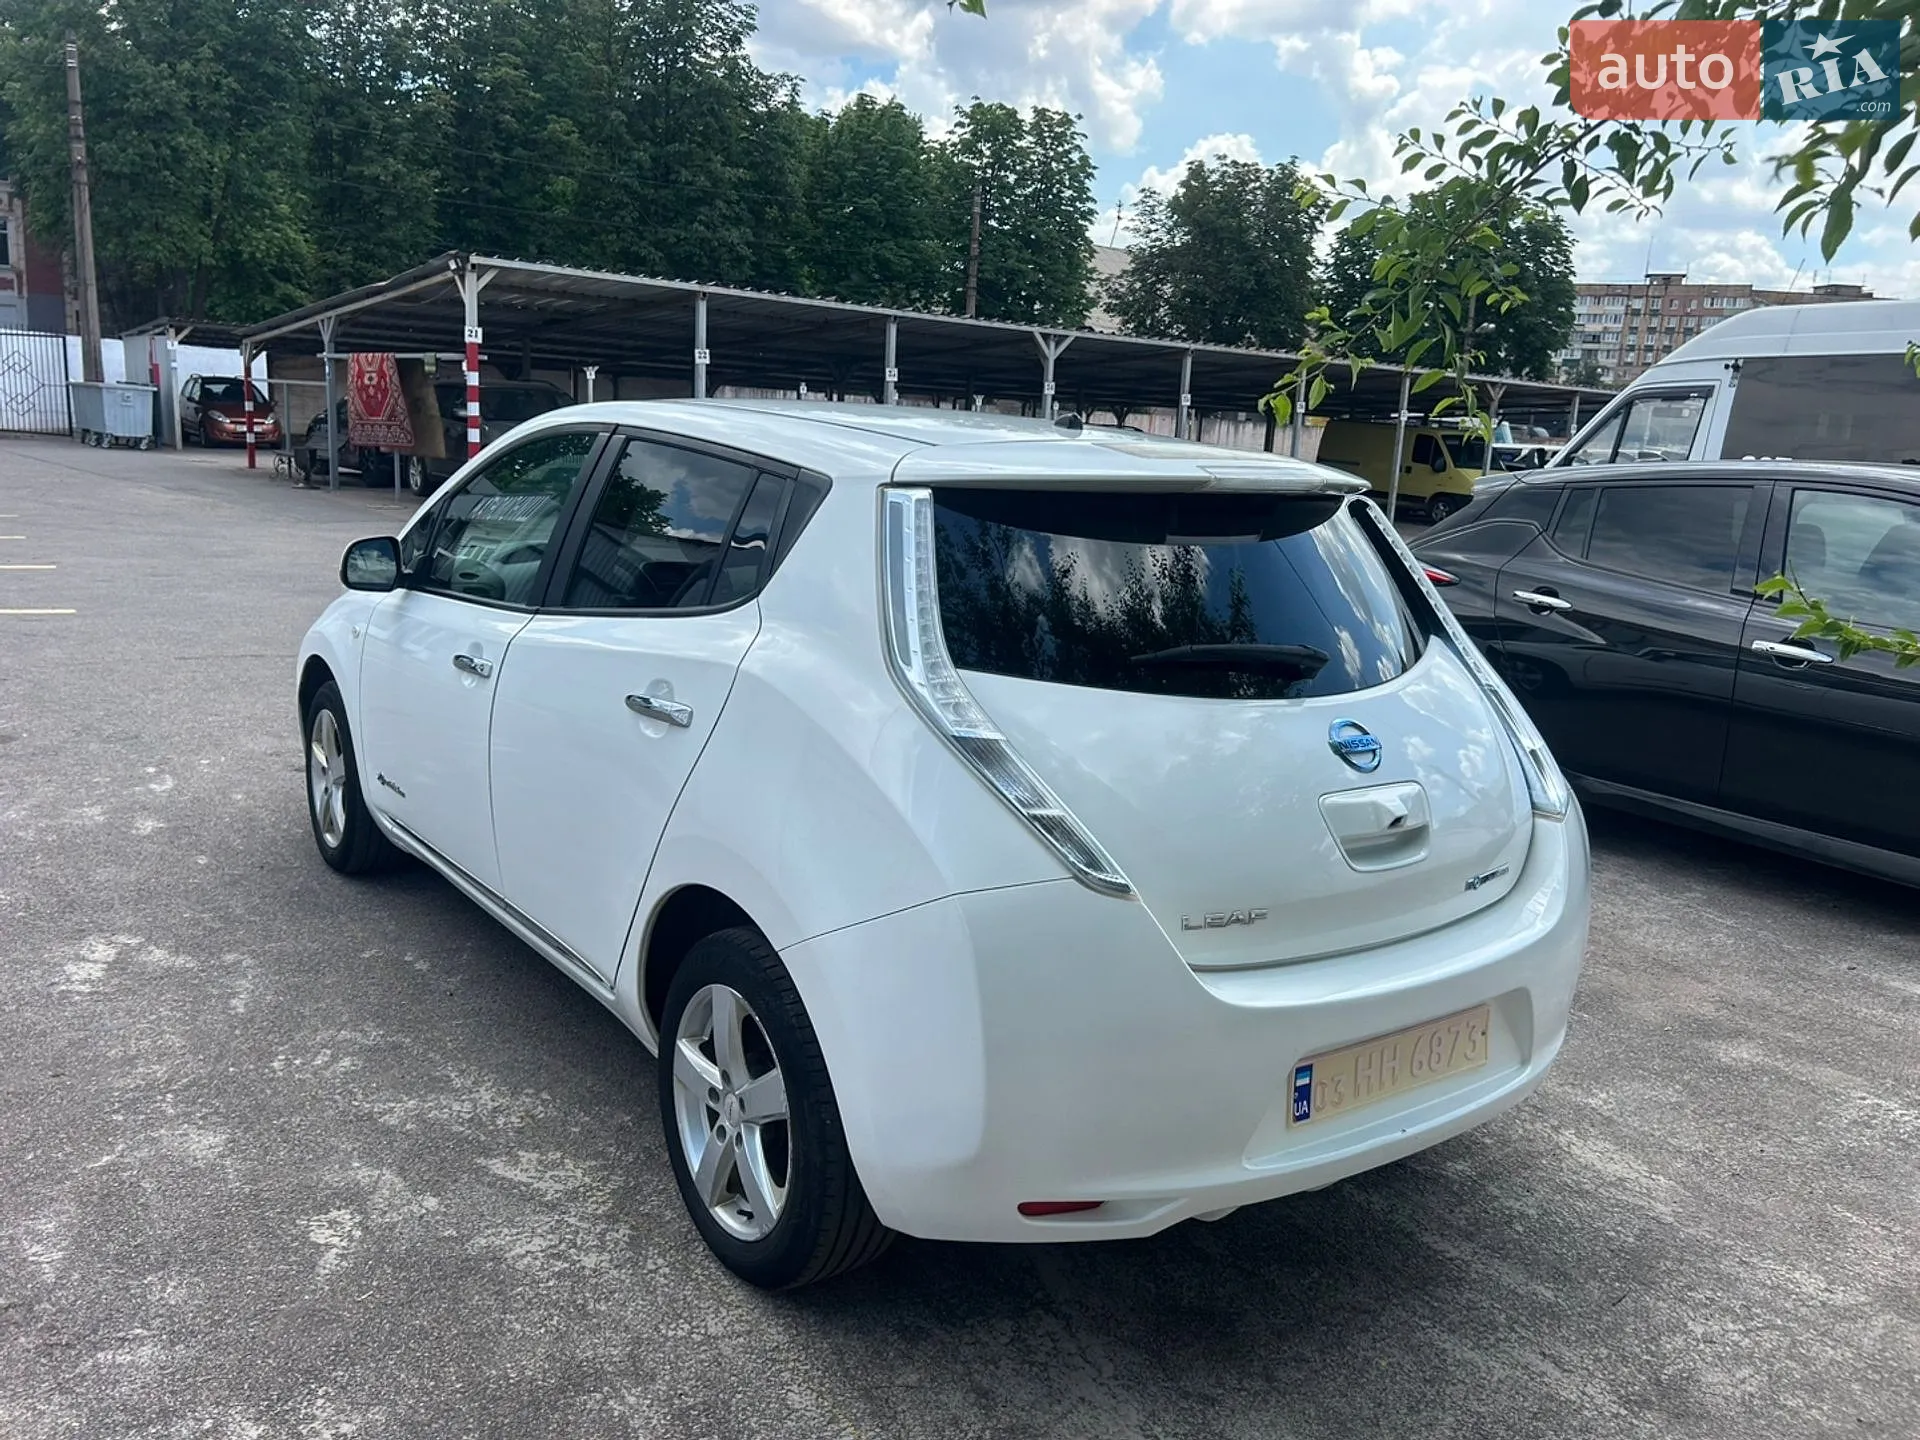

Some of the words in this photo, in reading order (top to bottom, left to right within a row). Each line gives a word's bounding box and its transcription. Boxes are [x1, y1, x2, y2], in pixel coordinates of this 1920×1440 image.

[1337, 737, 1380, 750] NISSAN
[1181, 907, 1269, 932] LEAF
[1294, 1100, 1309, 1116] UA
